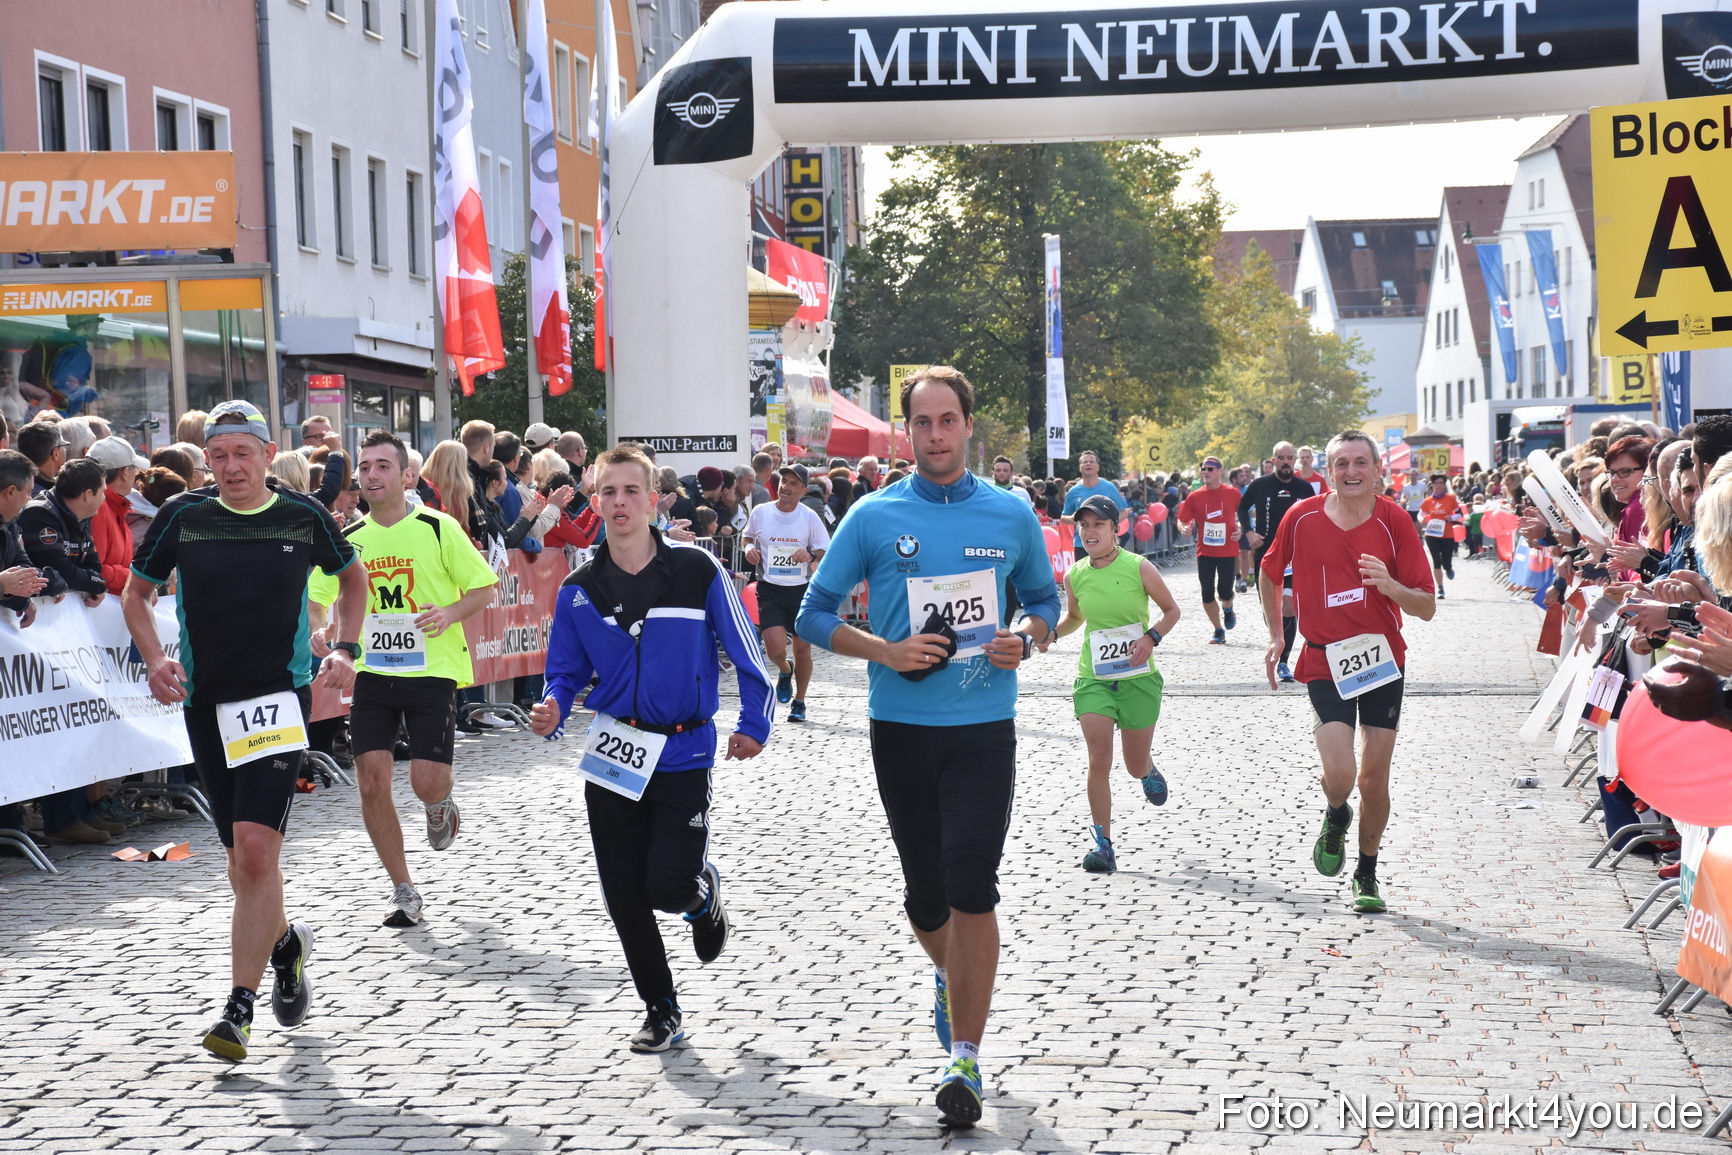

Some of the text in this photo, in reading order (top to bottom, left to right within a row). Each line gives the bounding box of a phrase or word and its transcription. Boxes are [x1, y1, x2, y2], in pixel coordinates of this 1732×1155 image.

[848, 0, 1553, 87] MINI NEUMARKT.
[690, 105, 716, 116] MINI
[0, 178, 215, 226] ARKT.DE
[1634, 175, 1732, 299] A
[3, 289, 153, 310] RUNMARKT.DE
[1623, 361, 1645, 391] B
[644, 436, 733, 451] MINI-Partl.de
[1149, 445, 1160, 462] C
[1438, 454, 1447, 467] D
[1206, 529, 1223, 538] 2512
[964, 547, 1006, 559] BOCK
[363, 555, 414, 571] Müller
[378, 584, 404, 610] M
[1337, 593, 1354, 603] DEHN
[372, 631, 415, 650] 2046
[384, 655, 404, 663] Tobias
[1112, 660, 1131, 670] Nicole
[1339, 645, 1381, 677] 2317
[1357, 671, 1378, 684] Martin
[236, 703, 279, 733] 147
[248, 733, 282, 749] Andreas
[595, 731, 647, 769] 2293
[605, 767, 620, 779] Jan
